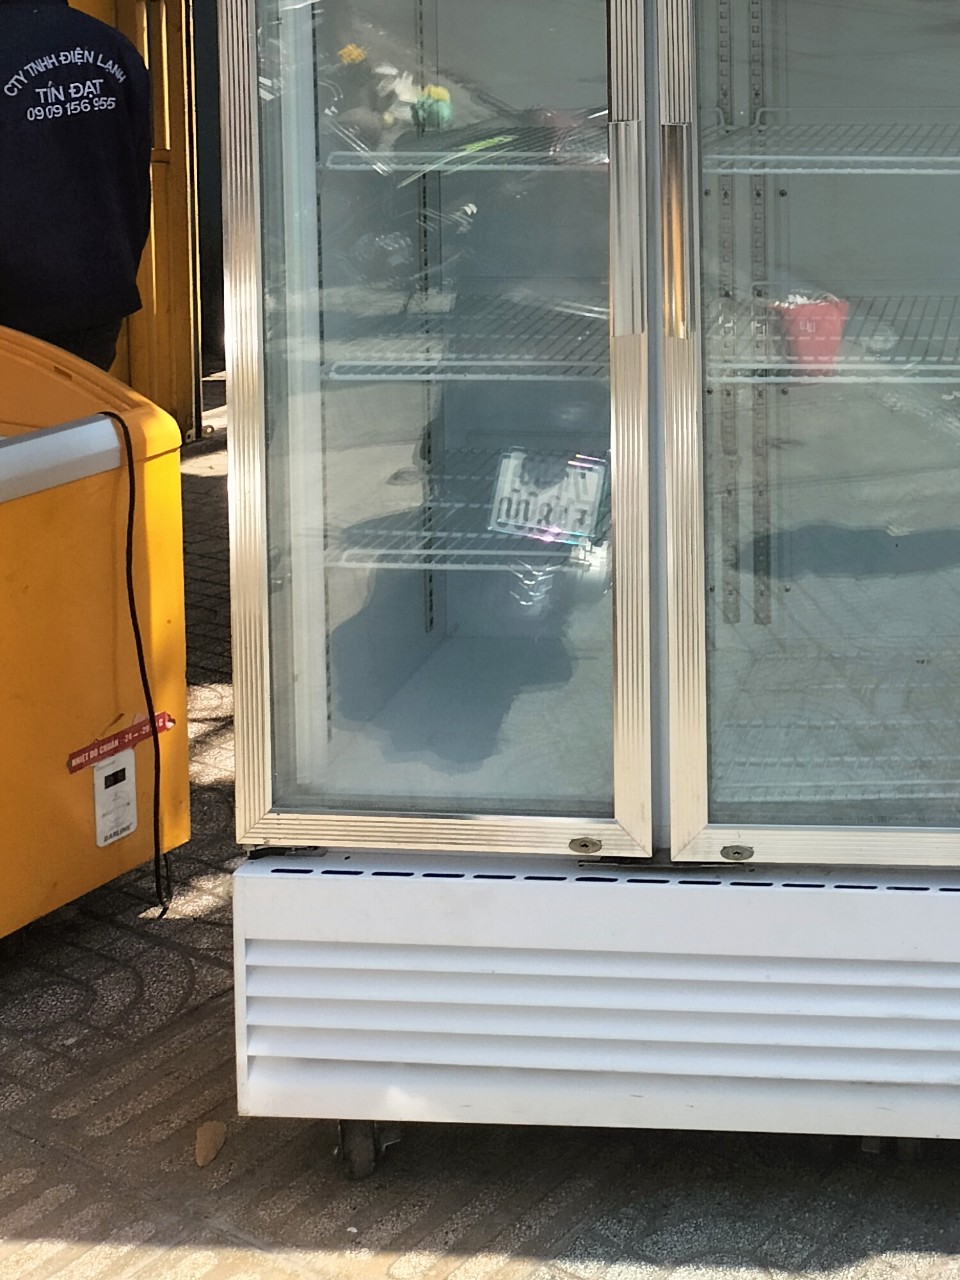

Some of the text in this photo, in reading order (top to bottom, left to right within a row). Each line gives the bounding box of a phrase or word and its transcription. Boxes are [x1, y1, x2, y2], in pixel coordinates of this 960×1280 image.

[3, 46, 127, 97] CTY TNHH ĐIỆN LẠNH
[35, 79, 104, 104] TÍN ĐẠT
[65, 99, 91, 116] 156
